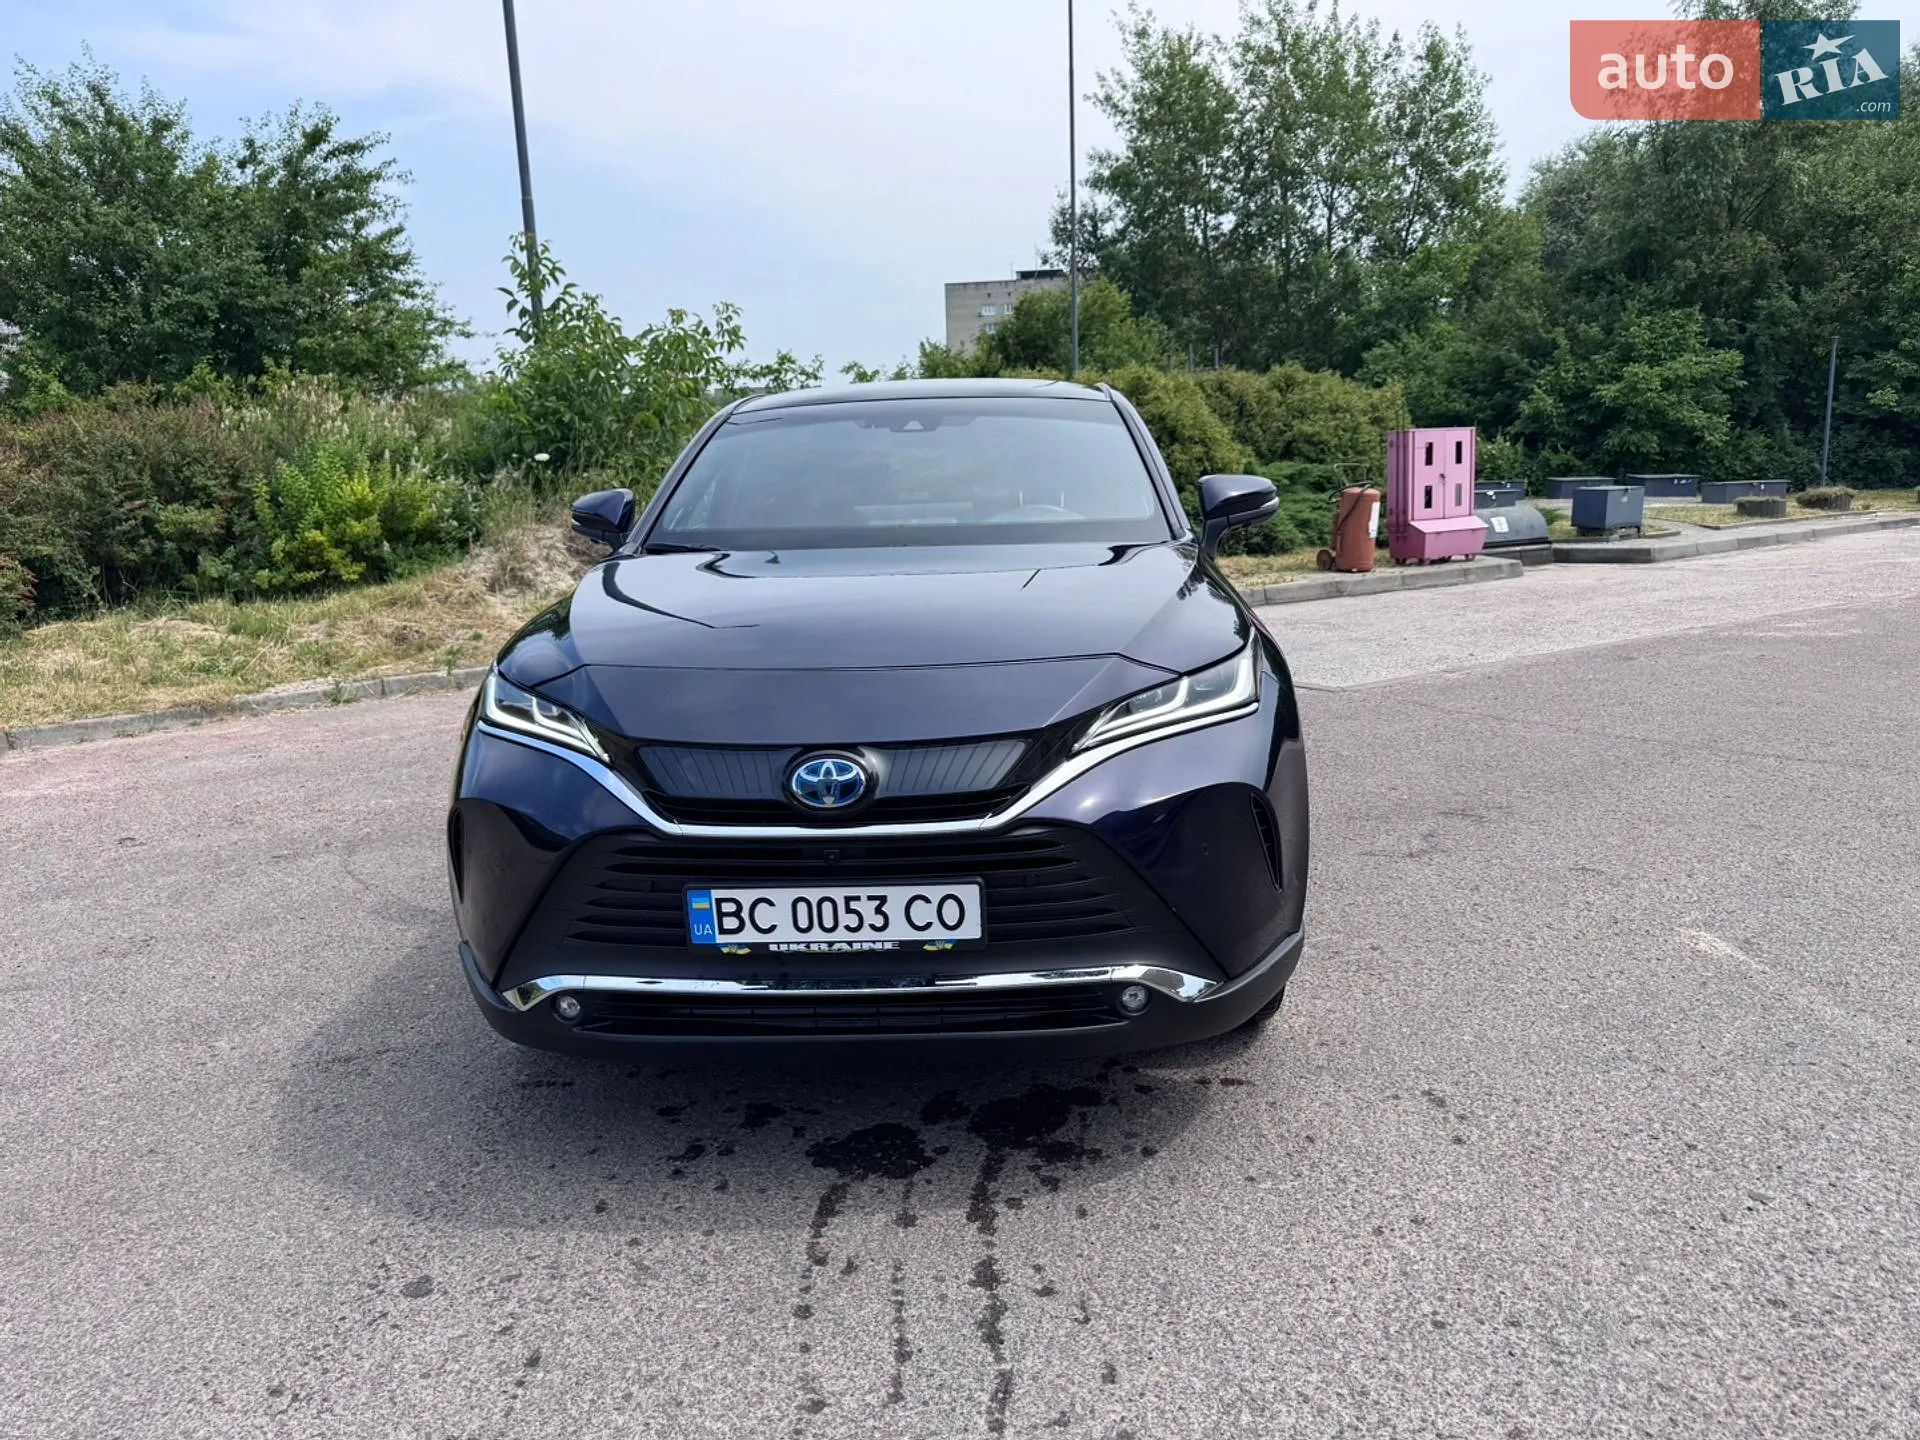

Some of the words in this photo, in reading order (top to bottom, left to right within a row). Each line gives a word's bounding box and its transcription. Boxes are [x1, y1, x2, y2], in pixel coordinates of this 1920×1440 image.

[715, 896, 778, 935] BC
[791, 894, 890, 934] 0053
[904, 893, 965, 932] CO
[693, 923, 713, 937] UA
[768, 941, 900, 953] UKRAINE
